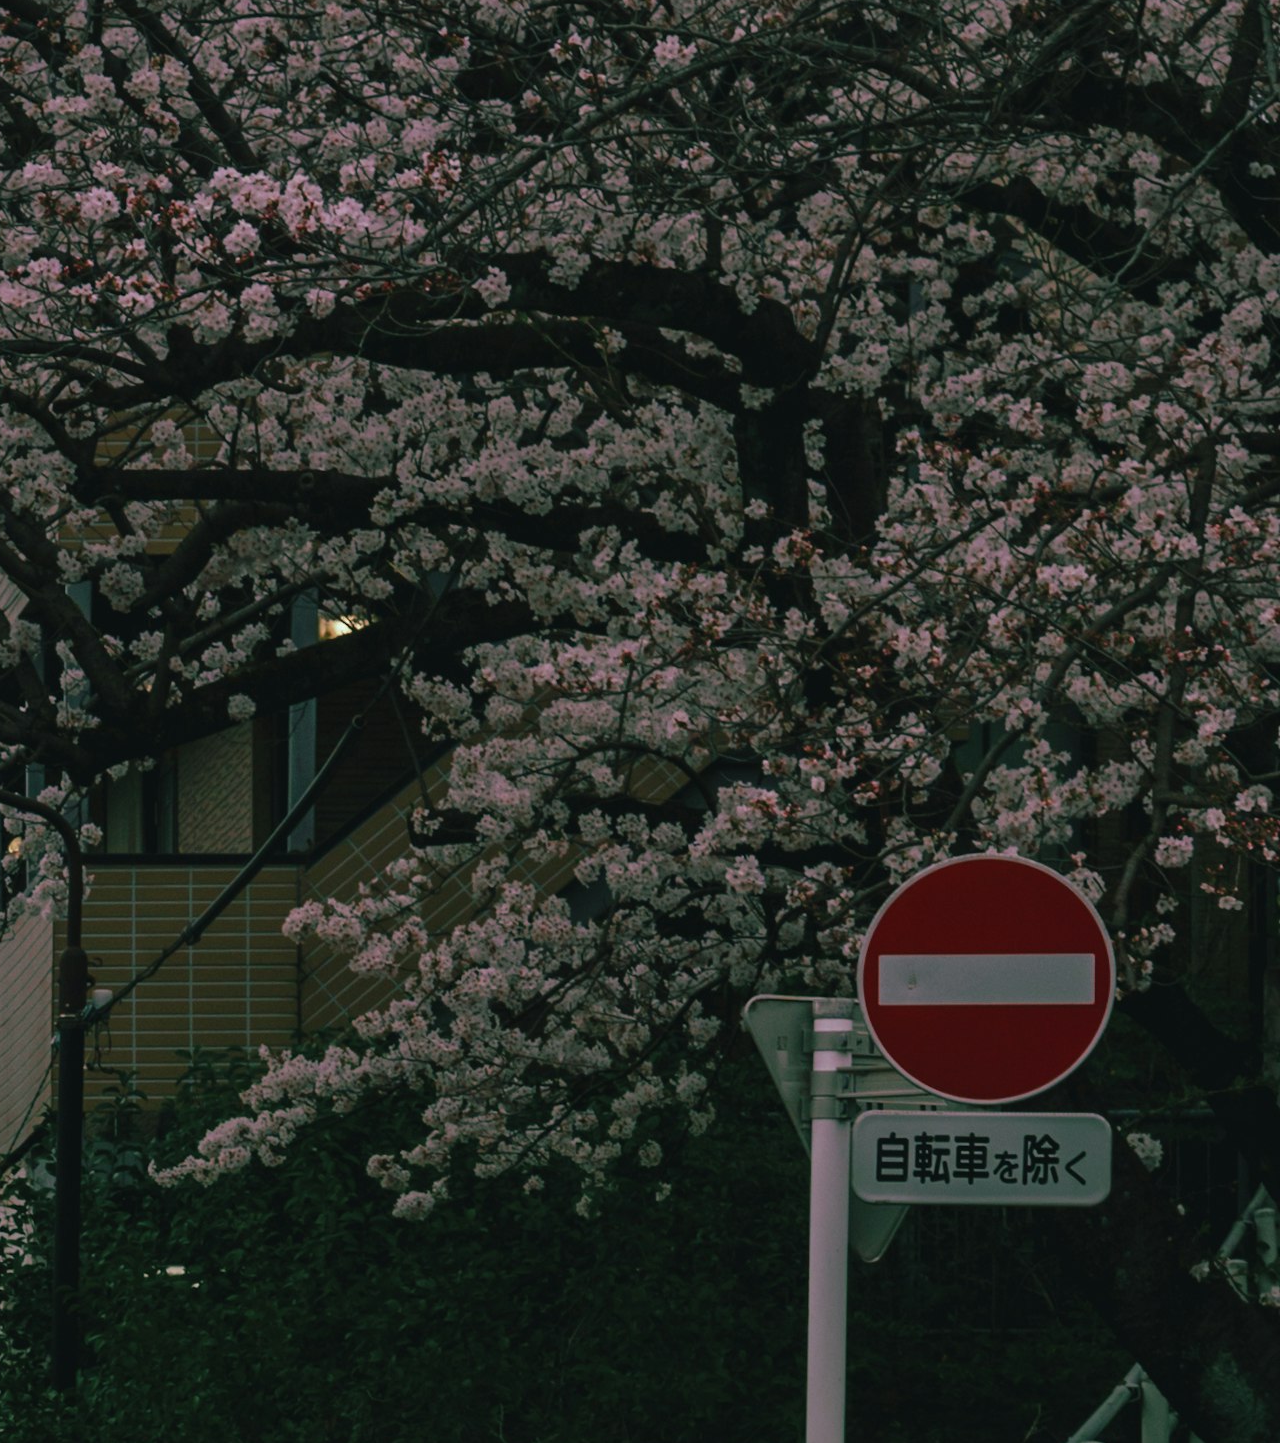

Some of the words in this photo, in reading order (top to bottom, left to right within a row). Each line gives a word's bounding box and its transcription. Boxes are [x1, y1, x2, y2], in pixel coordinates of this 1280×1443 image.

[876, 1132, 1087, 1186] 自転車を除く
